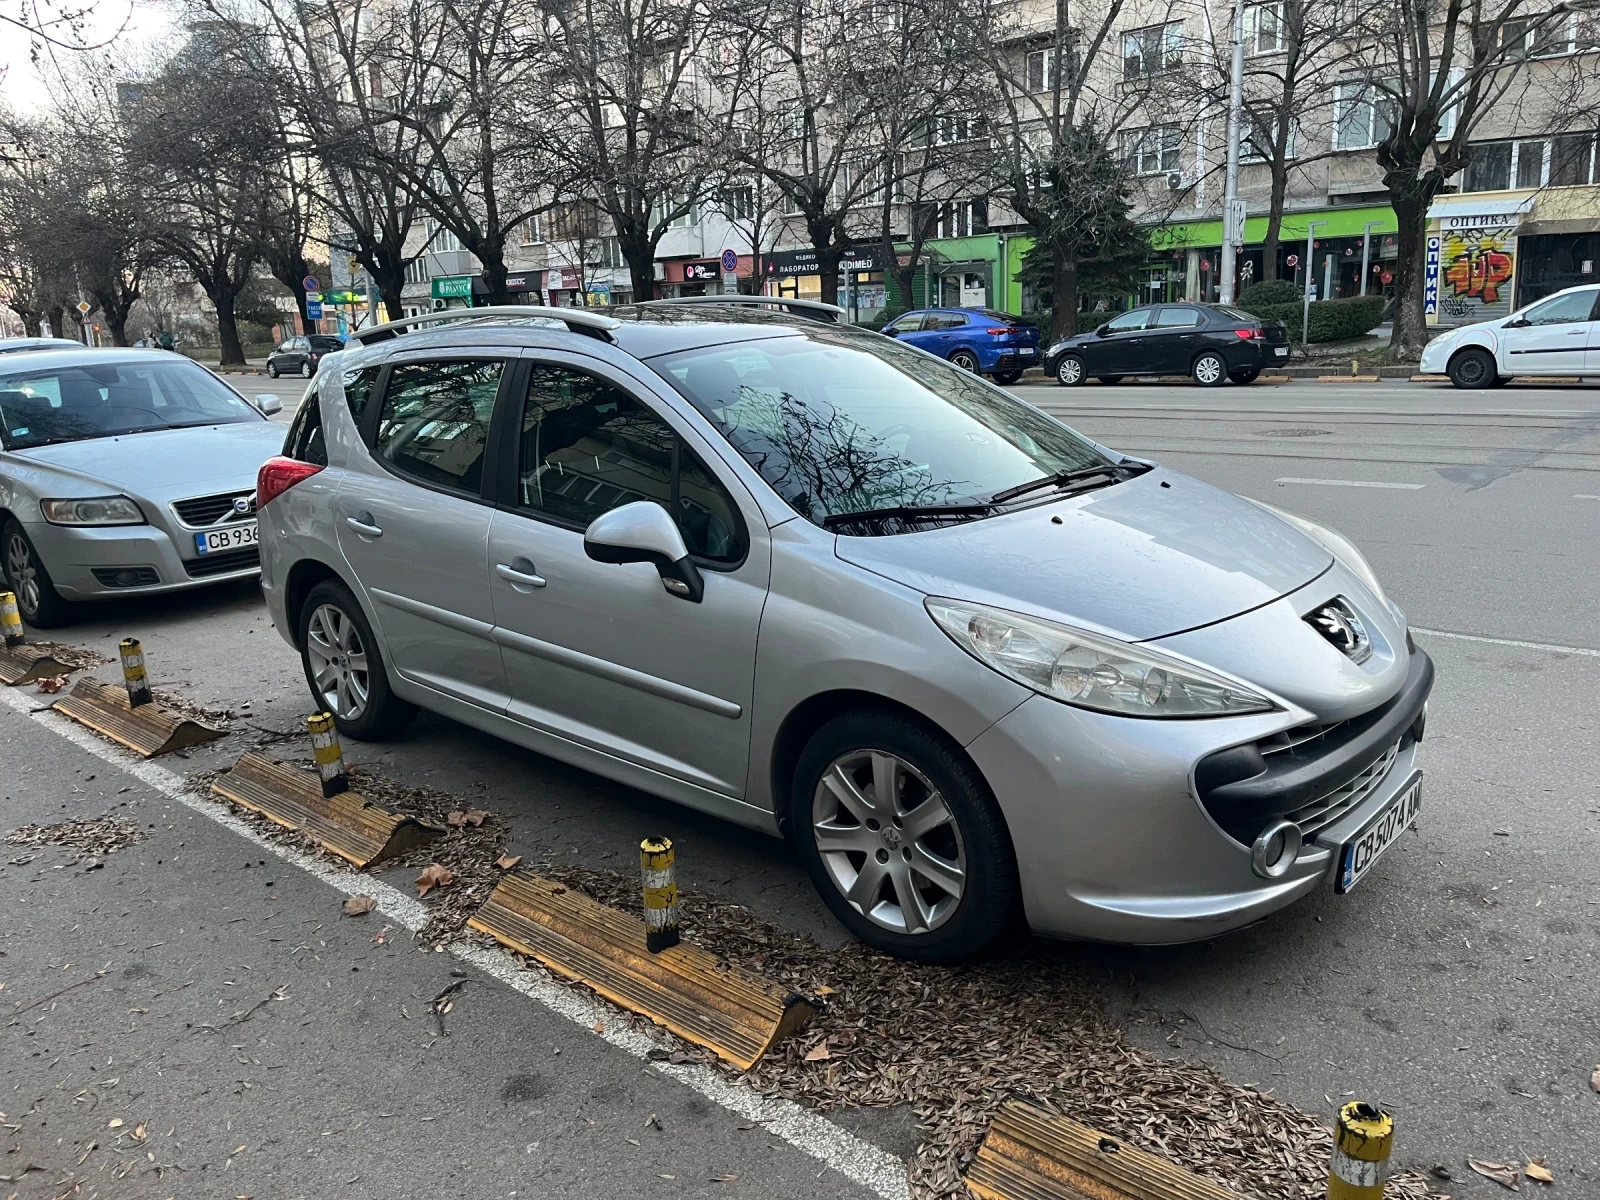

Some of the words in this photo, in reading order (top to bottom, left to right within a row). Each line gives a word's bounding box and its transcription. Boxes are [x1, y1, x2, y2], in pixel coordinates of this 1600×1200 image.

[1450, 214, 1509, 228] ОПТИКА
[1424, 238, 1439, 314] ОПТИКА
[208, 532, 231, 549] CB
[1354, 831, 1375, 874] CB
[1374, 798, 1406, 854] 5074
